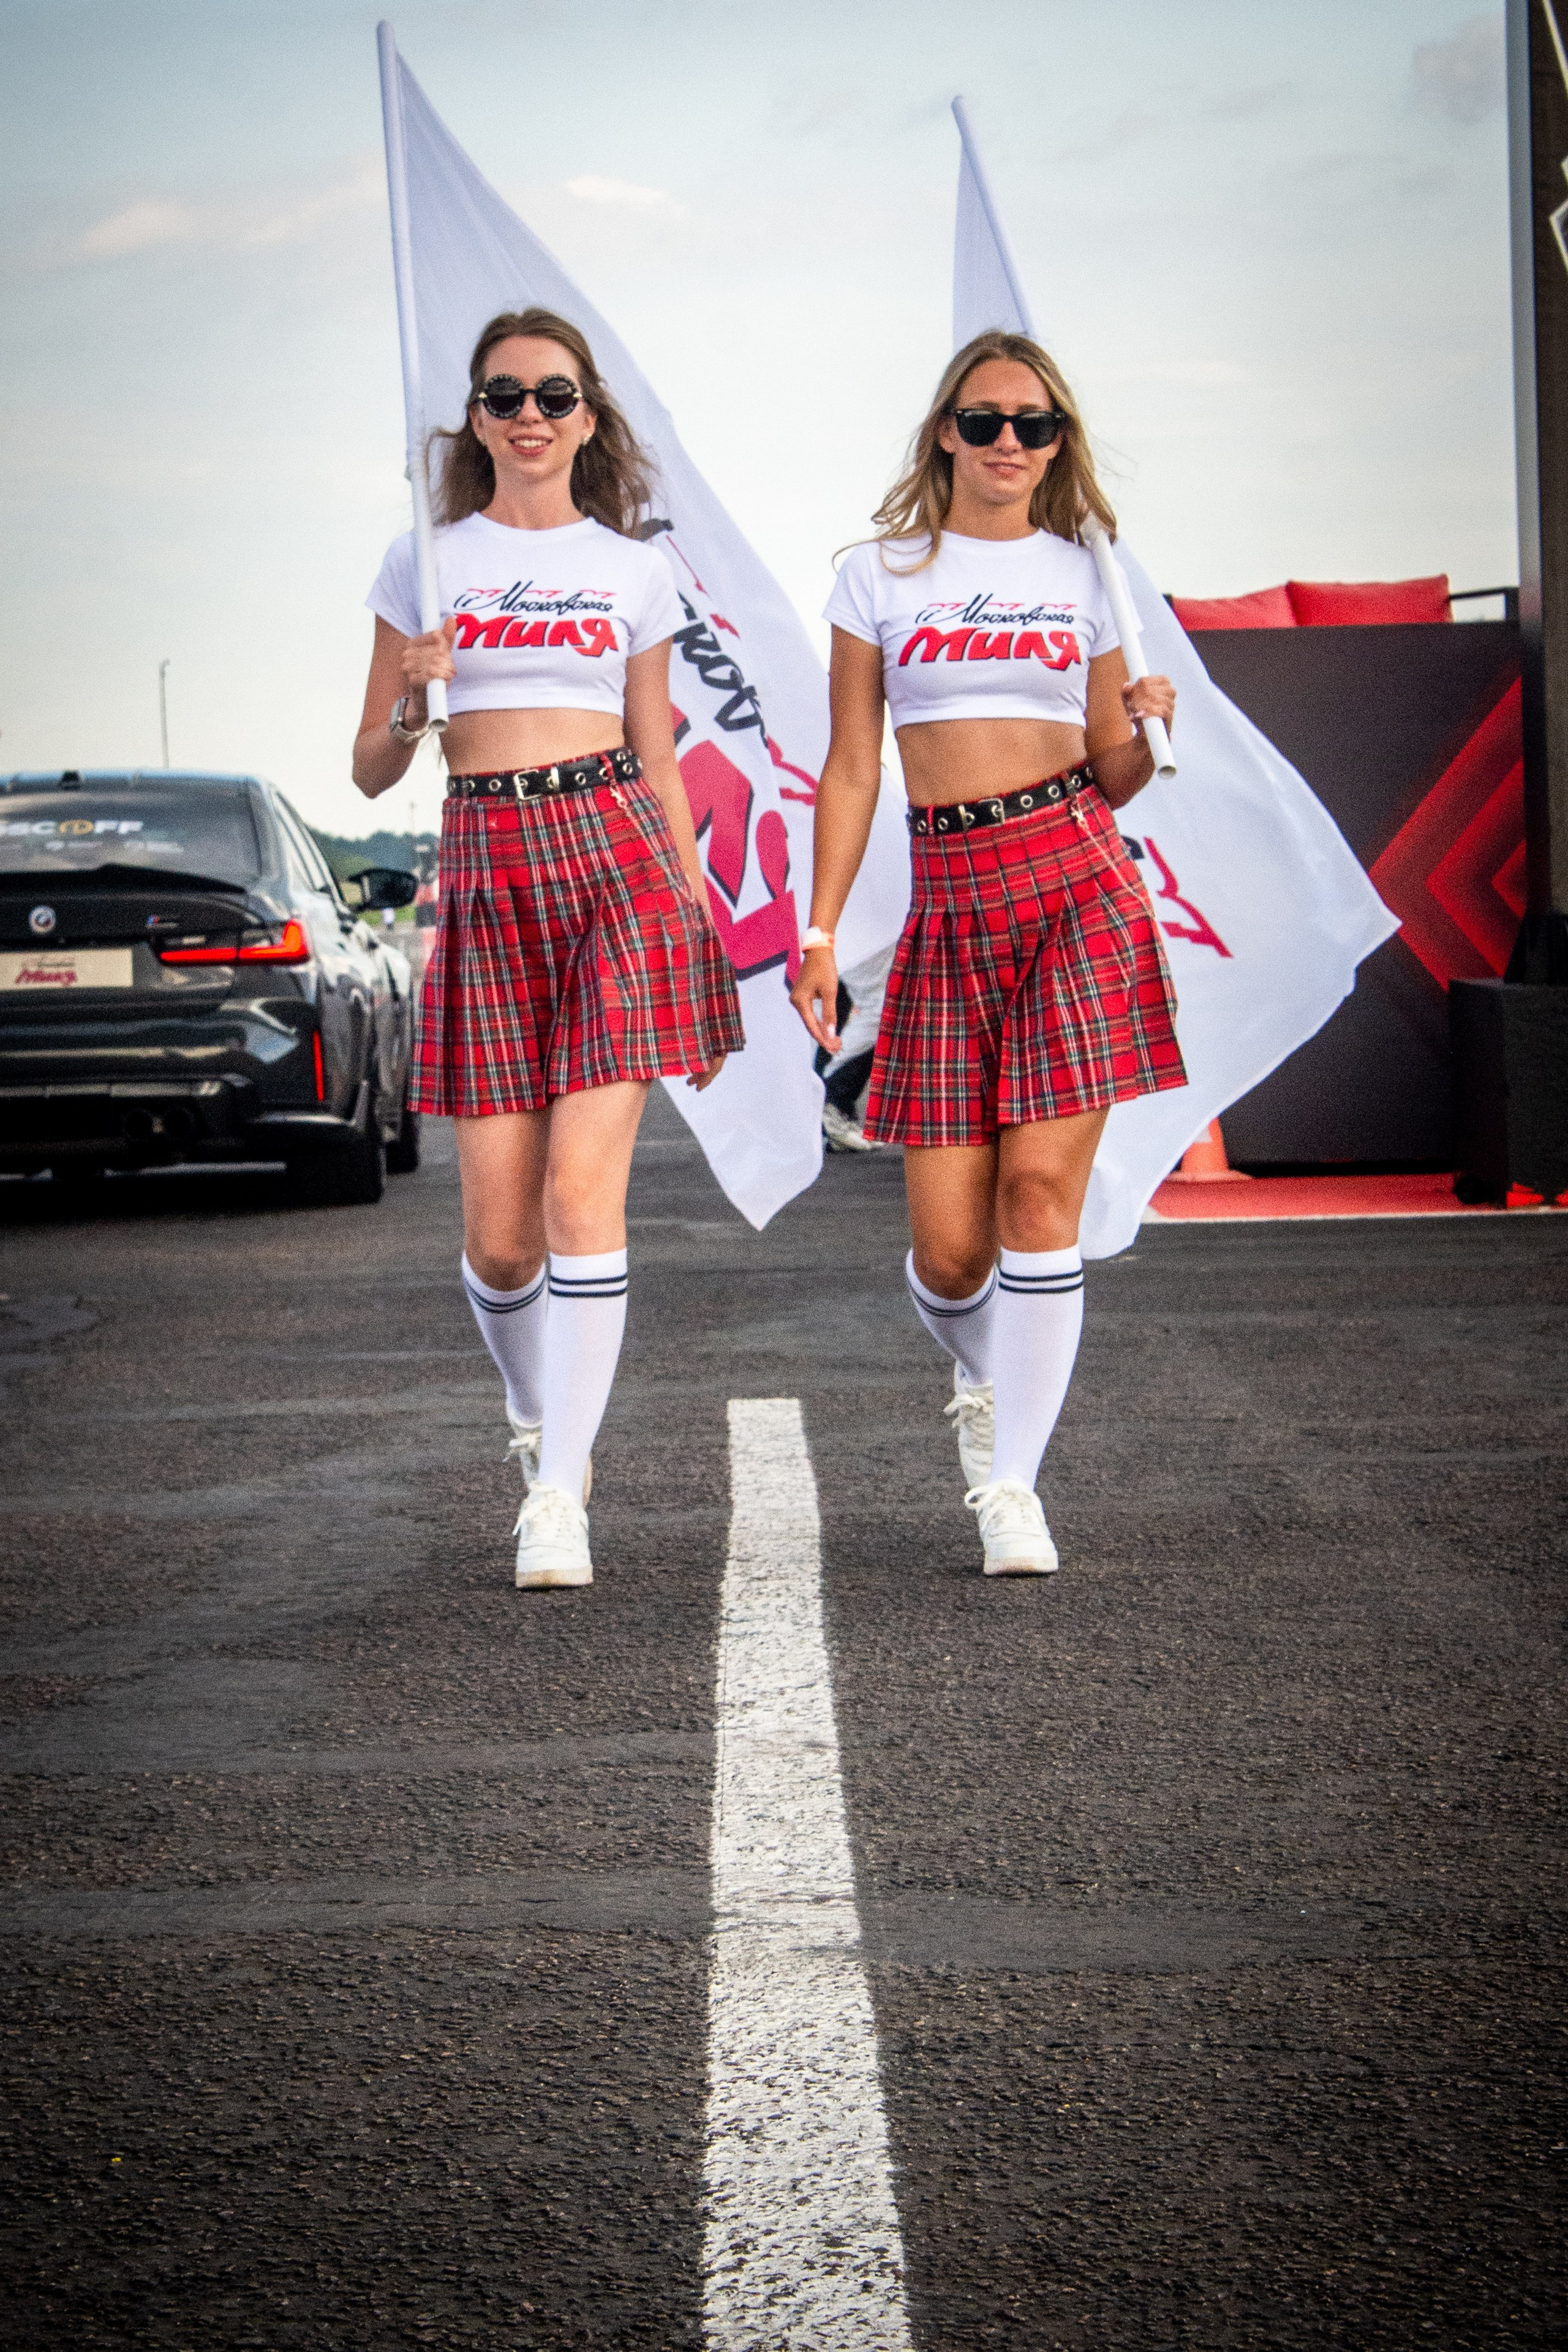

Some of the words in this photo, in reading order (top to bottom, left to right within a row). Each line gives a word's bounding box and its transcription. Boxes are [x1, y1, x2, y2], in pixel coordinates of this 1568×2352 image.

[454, 581, 612, 615] Московская
[915, 594, 1074, 625] Московская
[456, 613, 619, 657] Миля
[898, 626, 1082, 671] Миля
